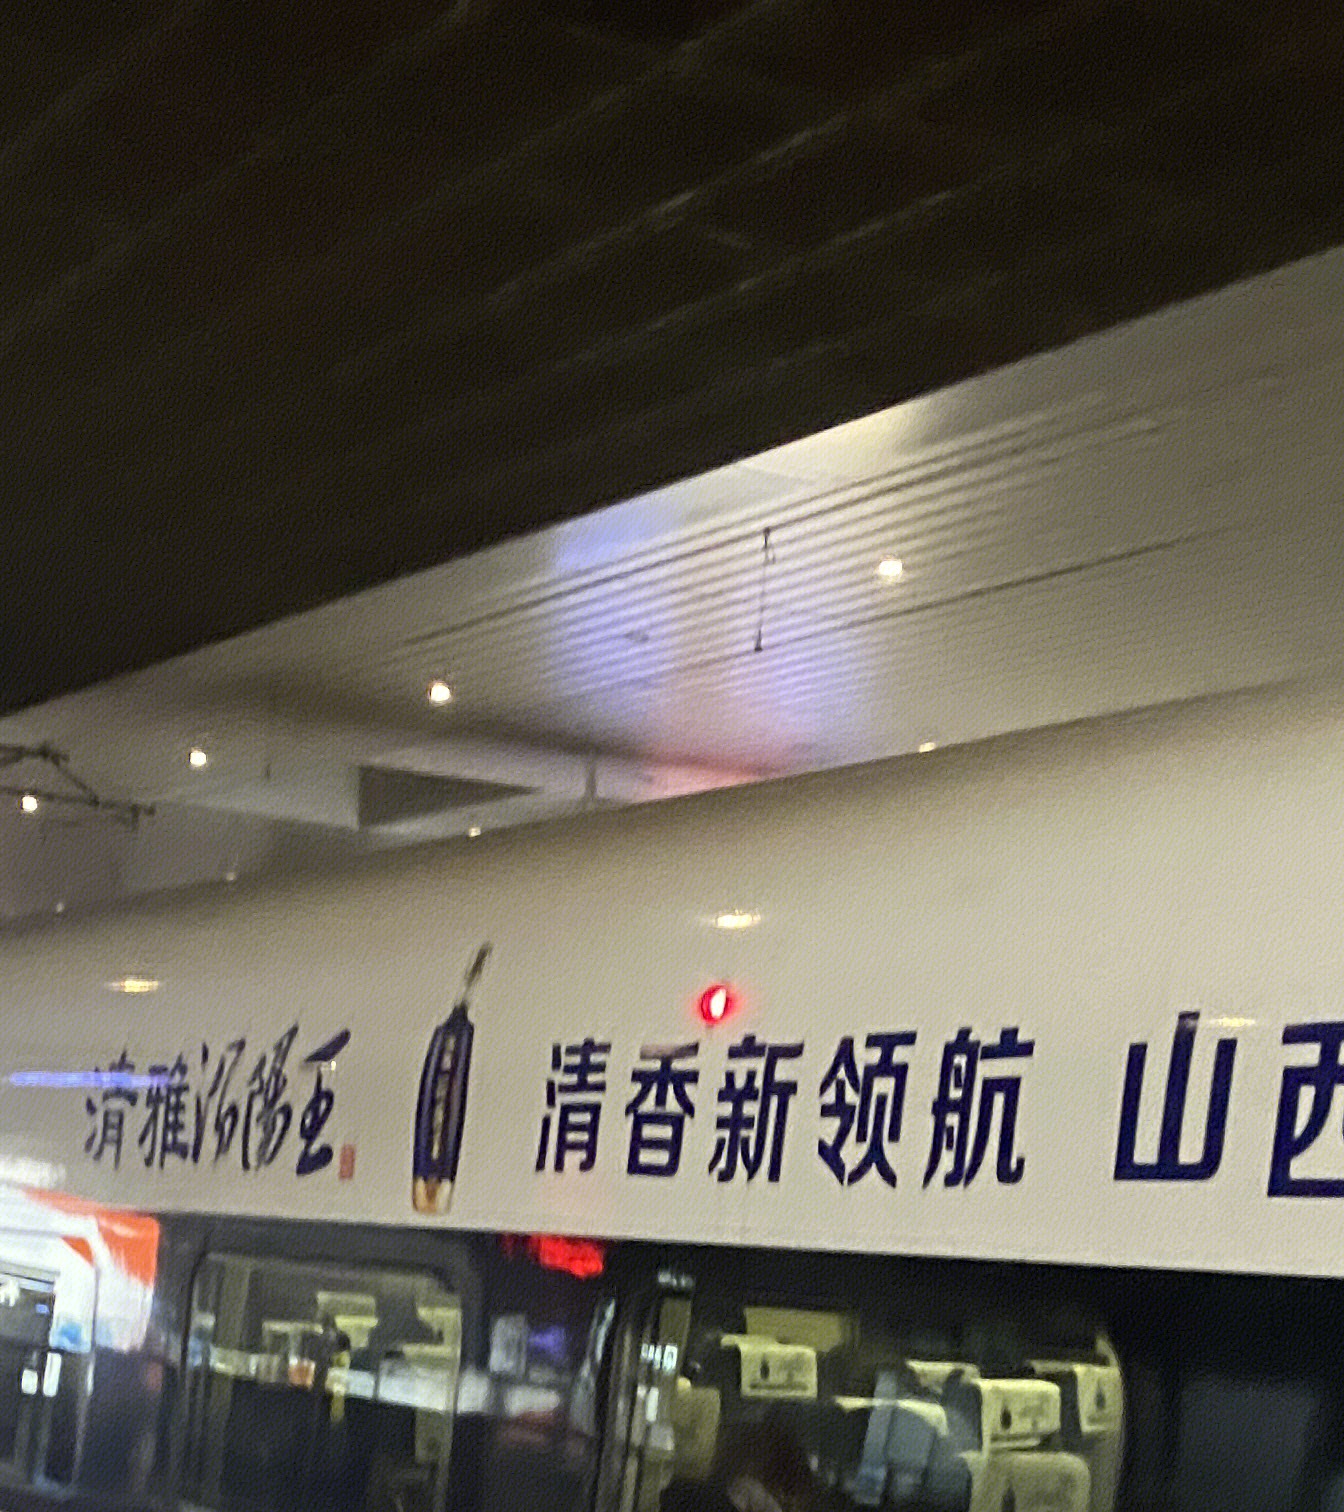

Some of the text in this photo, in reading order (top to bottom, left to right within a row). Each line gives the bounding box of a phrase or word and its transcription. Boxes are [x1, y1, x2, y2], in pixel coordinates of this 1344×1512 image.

[536, 1027, 1035, 1188] 清香新领航
